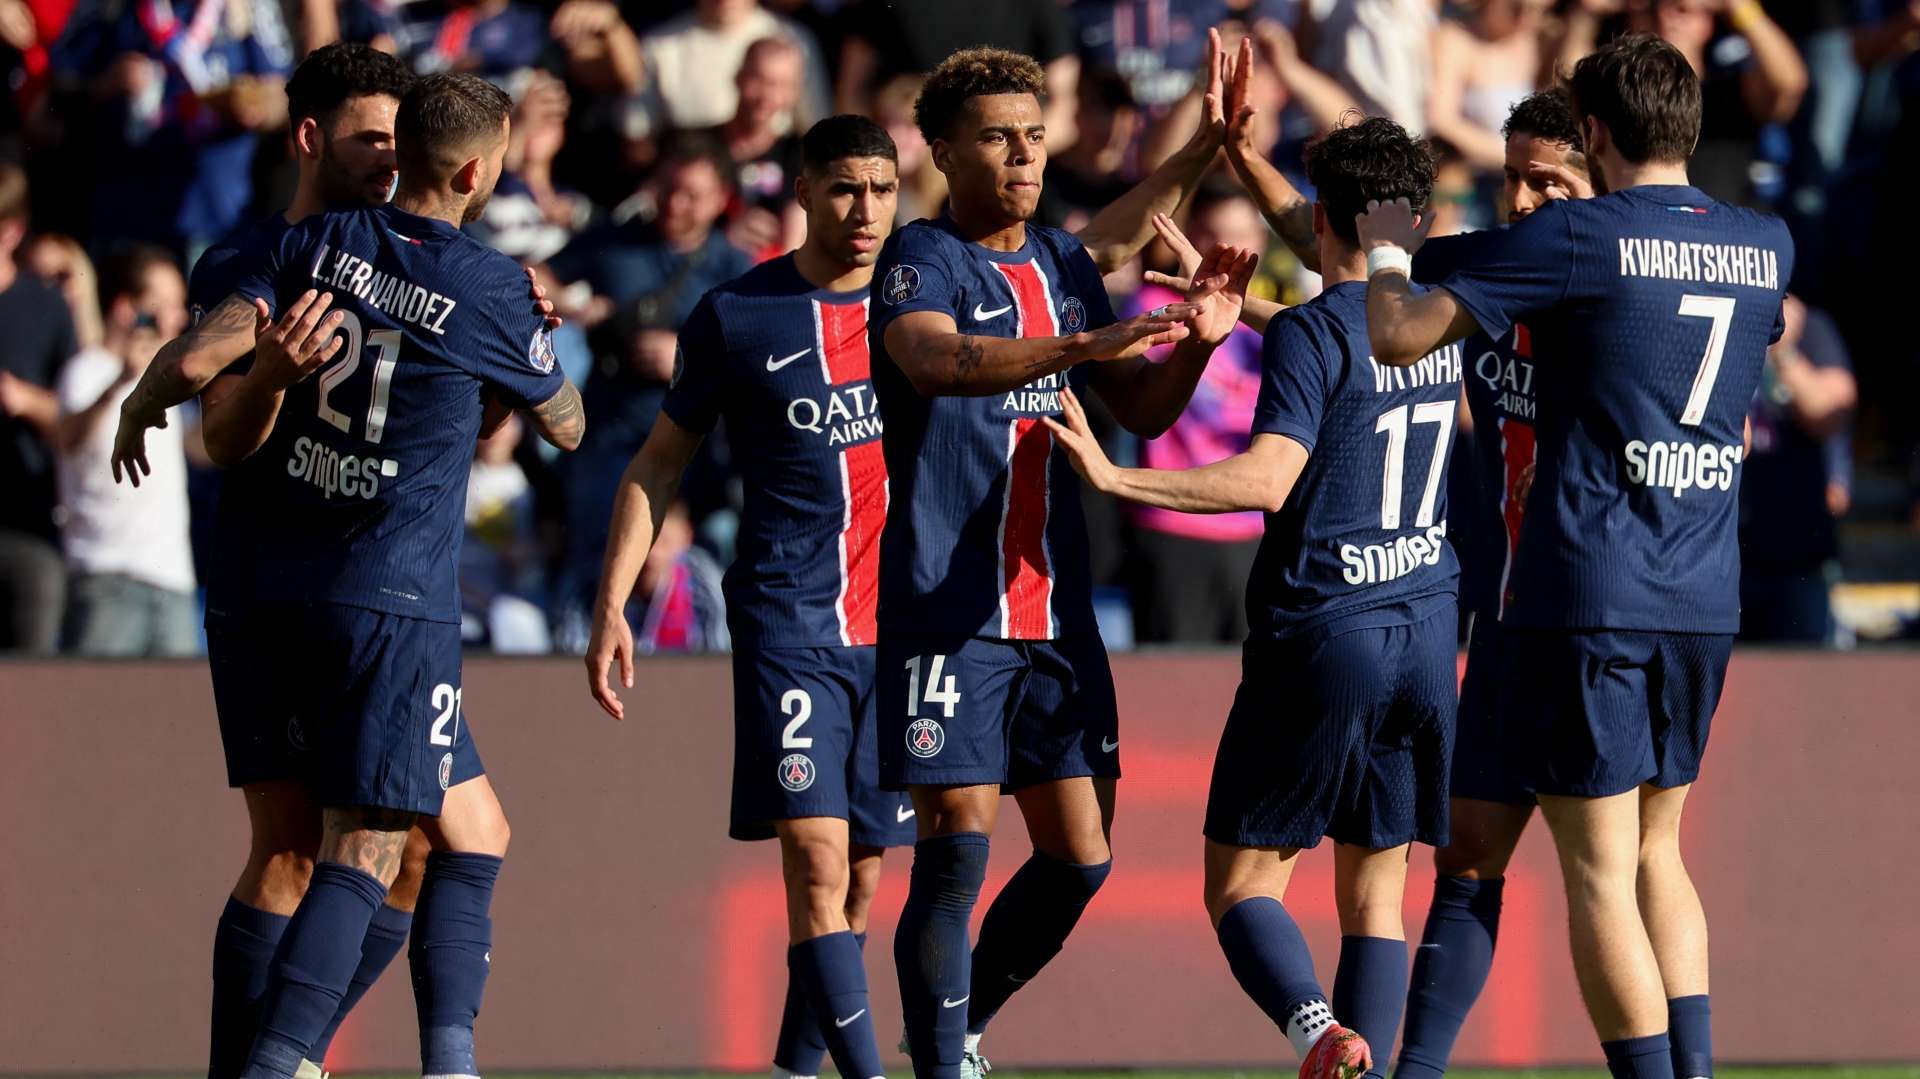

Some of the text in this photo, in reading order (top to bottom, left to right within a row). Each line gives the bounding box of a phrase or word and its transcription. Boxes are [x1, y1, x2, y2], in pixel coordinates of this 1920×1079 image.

[312, 244, 456, 335] L.HERNANDEZ
[1619, 238, 1778, 290] KVARATSKHELIA
[318, 308, 403, 444] 21
[1475, 351, 1536, 397] QAT
[1678, 295, 1736, 426] 7
[1375, 400, 1456, 529] 17
[904, 654, 961, 717] 14
[780, 689, 813, 749] 2
[912, 720, 938, 731] PARIS
